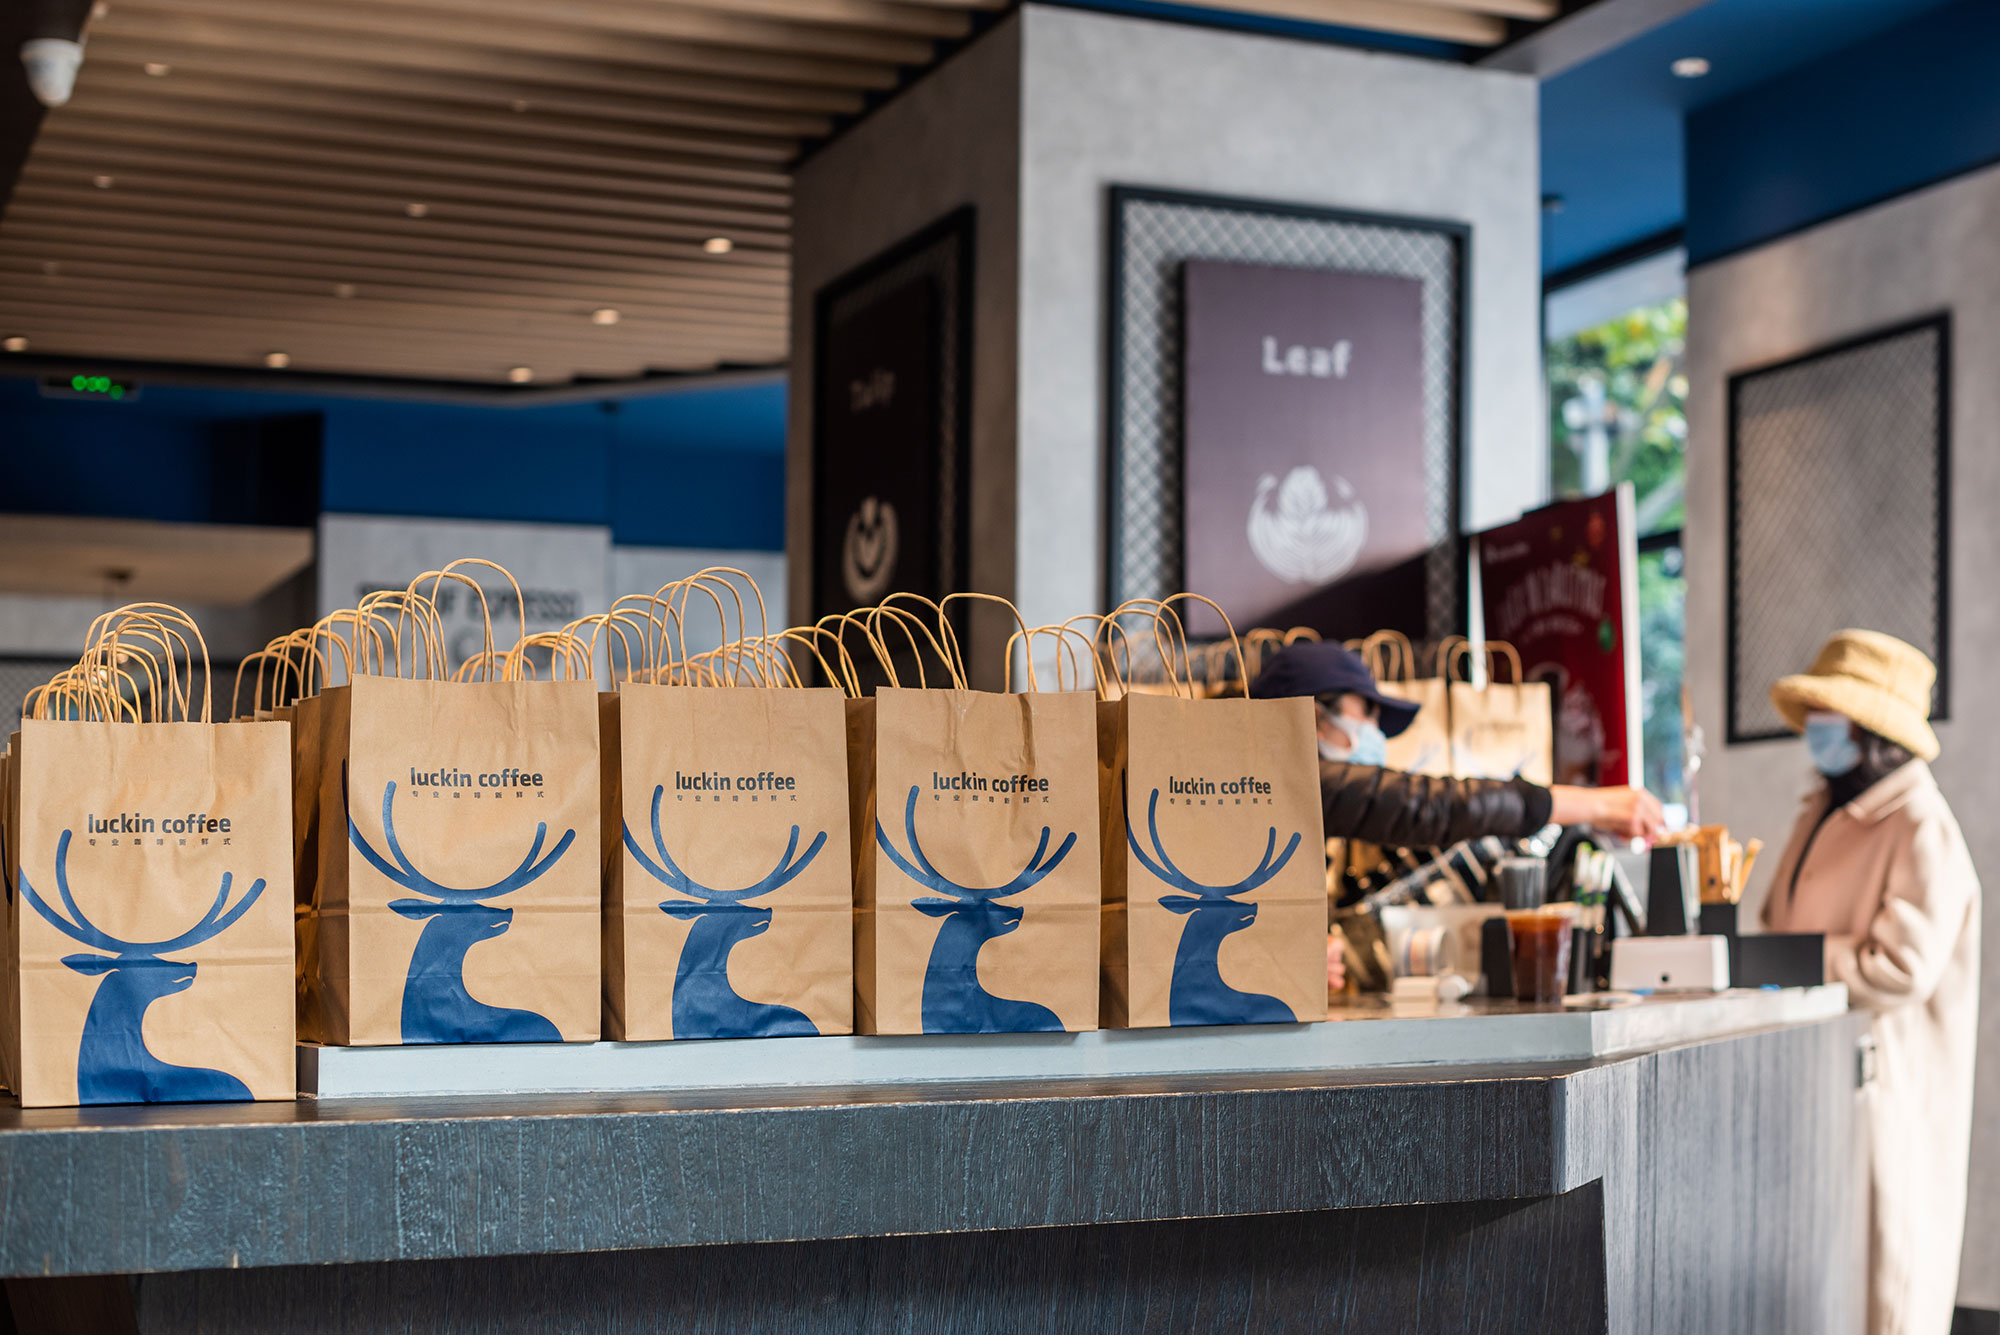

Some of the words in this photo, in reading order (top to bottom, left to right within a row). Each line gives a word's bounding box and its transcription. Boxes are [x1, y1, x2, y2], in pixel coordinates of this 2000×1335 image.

[1262, 336, 1352, 378] Leaf
[411, 766, 472, 788] luckin
[478, 767, 544, 788] coffee
[676, 770, 731, 791] luckin
[736, 771, 796, 791] coffee
[933, 771, 988, 791] luckin
[992, 773, 1049, 793] coffee
[1169, 776, 1216, 796] luckin
[1220, 776, 1272, 795] coffee
[89, 813, 156, 835] luckin
[162, 813, 232, 835] coffee
